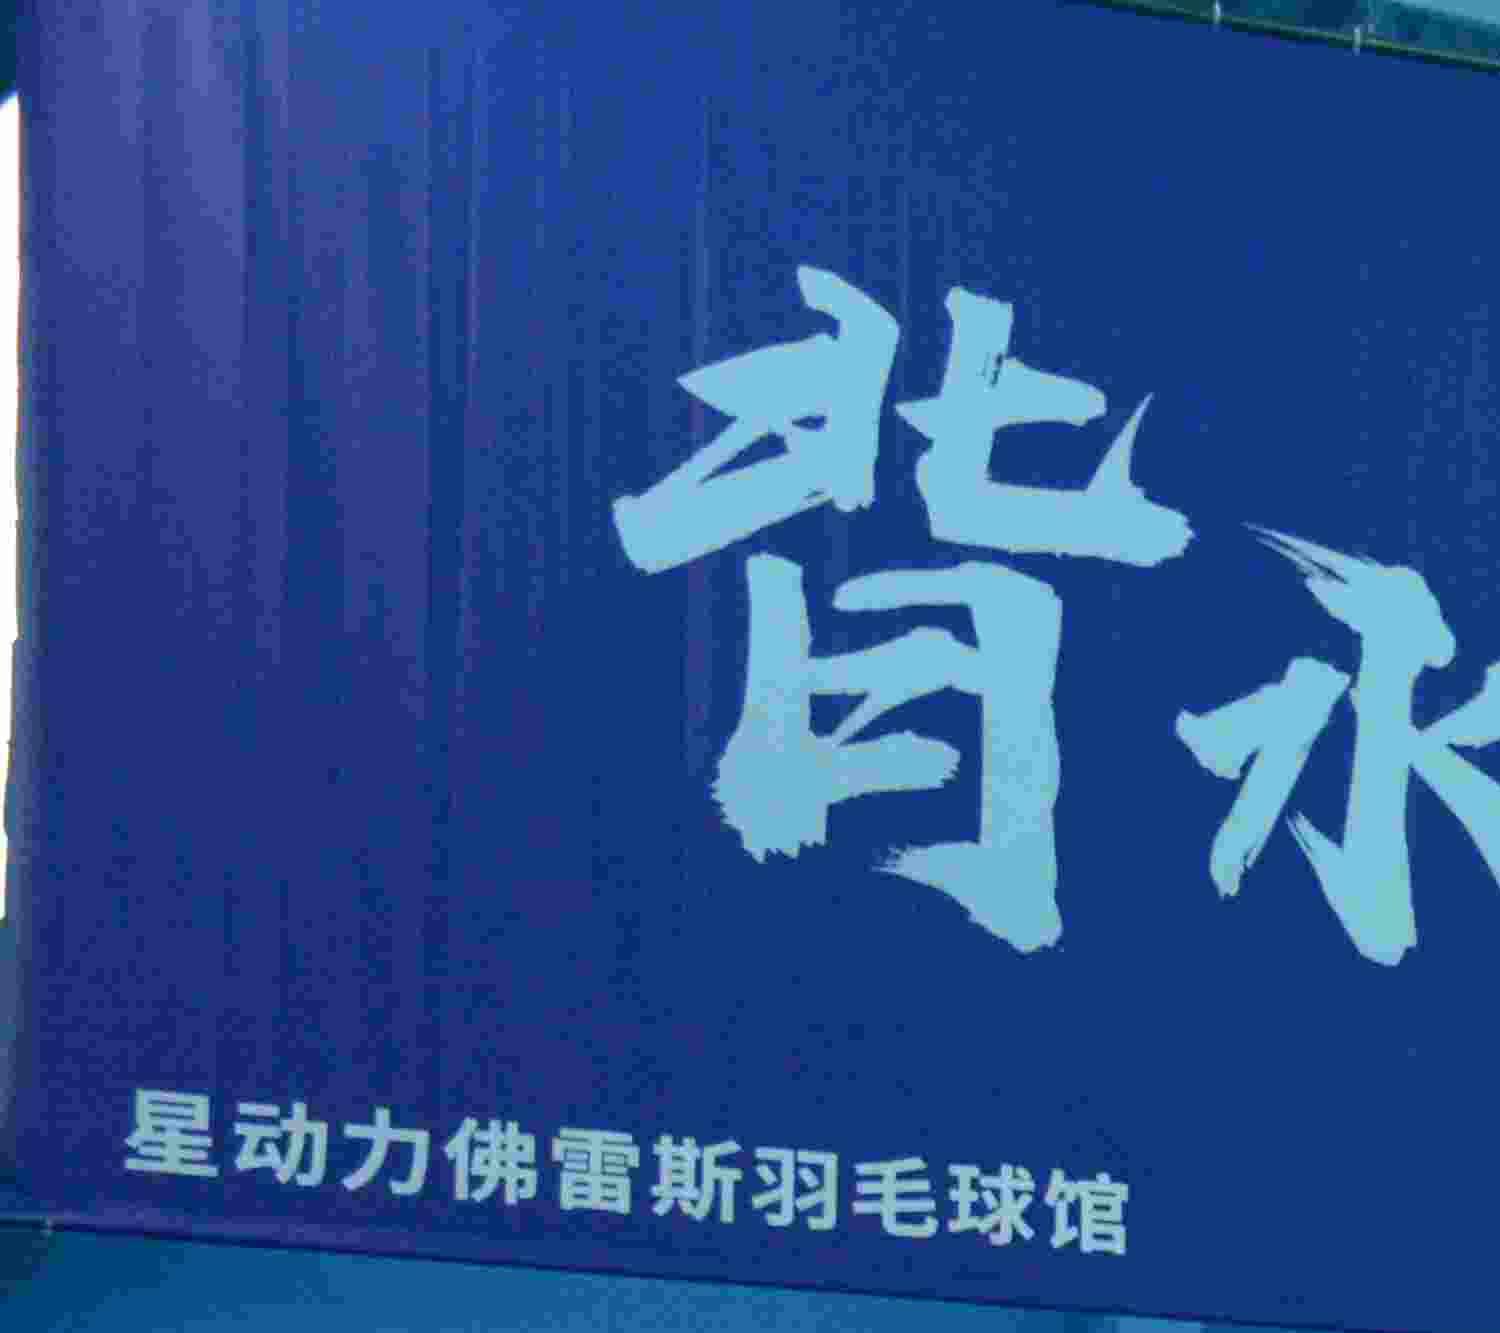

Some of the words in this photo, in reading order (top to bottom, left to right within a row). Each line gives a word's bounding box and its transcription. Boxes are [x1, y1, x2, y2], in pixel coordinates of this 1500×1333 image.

[124, 1088, 1129, 1255] 星动力佛雷斯羽毛球馆
